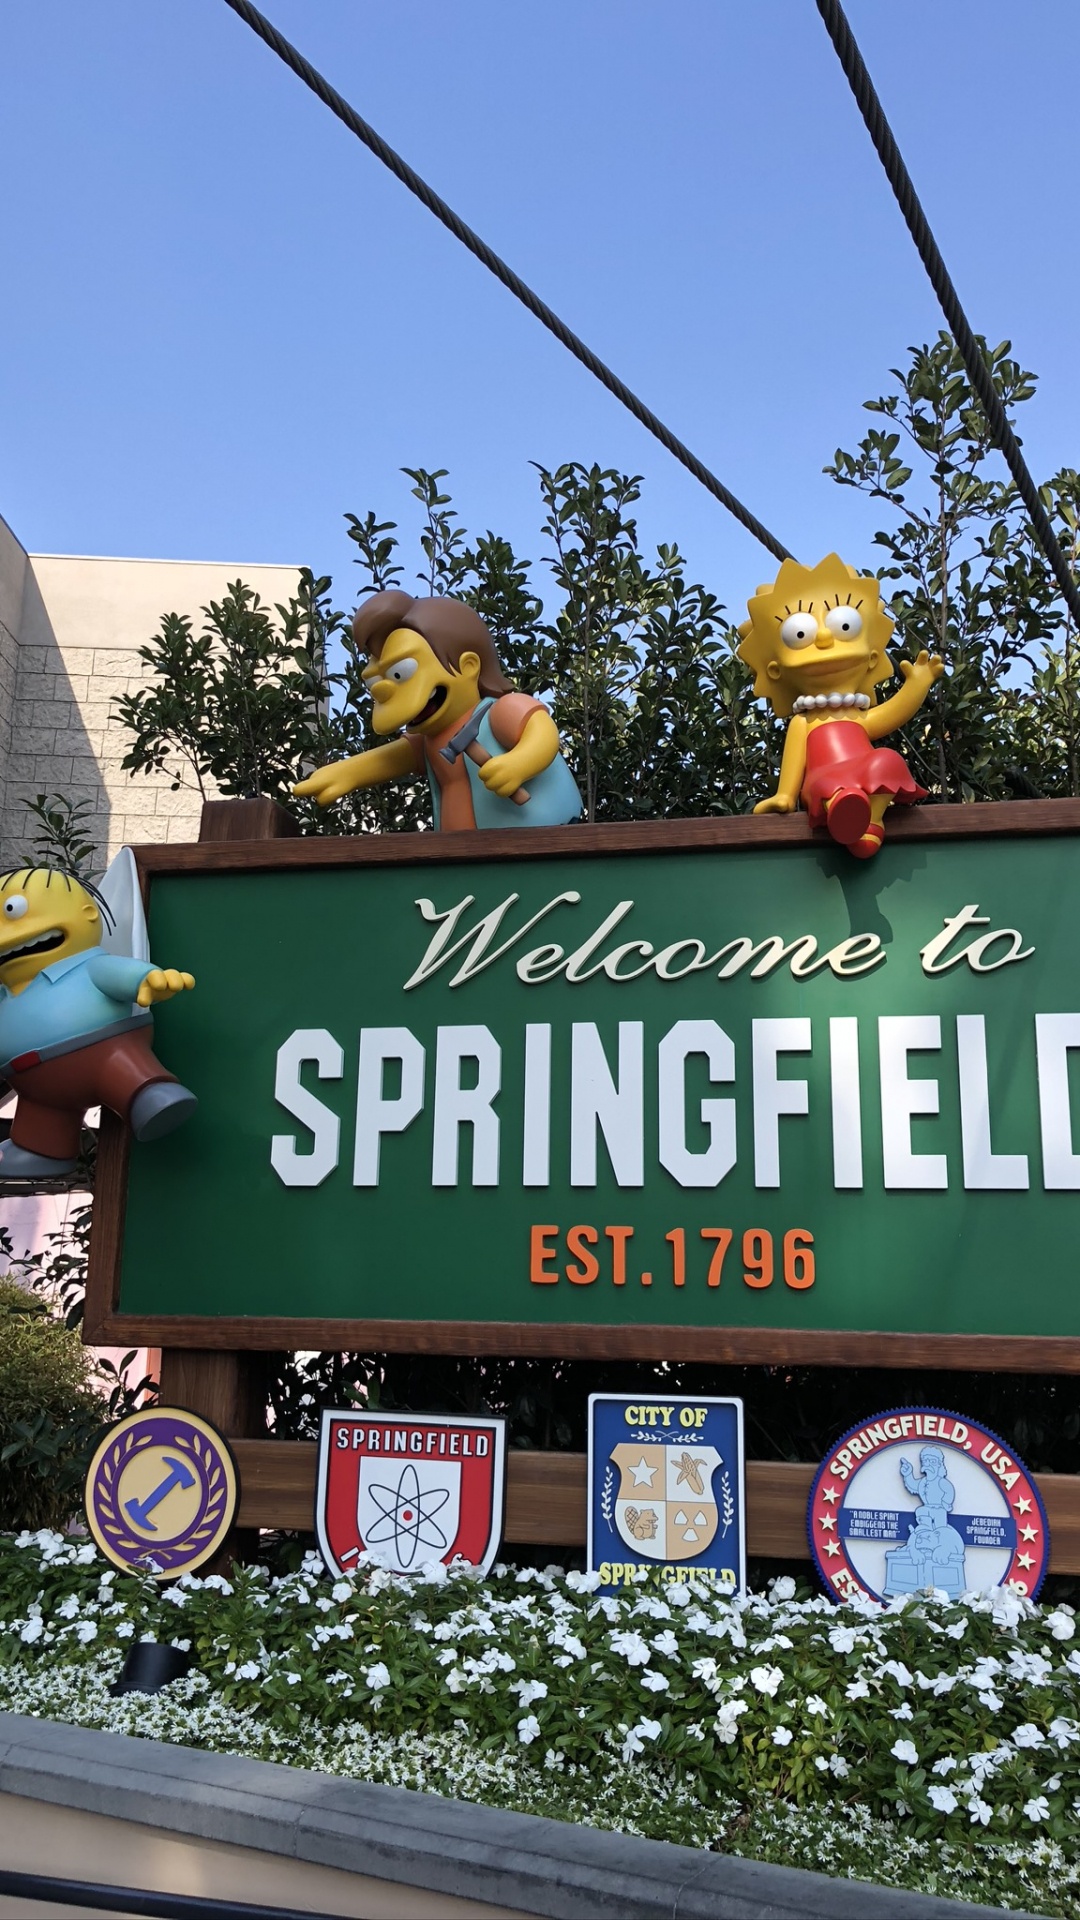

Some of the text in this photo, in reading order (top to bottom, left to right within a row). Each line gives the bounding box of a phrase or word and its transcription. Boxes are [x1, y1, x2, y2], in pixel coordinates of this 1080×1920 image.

[403, 891, 1036, 990] Welcome to
[270, 1013, 1080, 1189] SPRINGFIELD
[625, 1405, 708, 1427] CITY OF
[336, 1427, 489, 1457] SPRINGFIELD
[830, 1415, 1021, 1491] SPRINGFIELD, USA
[850, 1519, 899, 1530] EMBIGGENS THE
[858, 1511, 878, 1520] NOBLE
[878, 1512, 899, 1521] SPIRIT
[849, 1527, 882, 1538] SMALLEST
